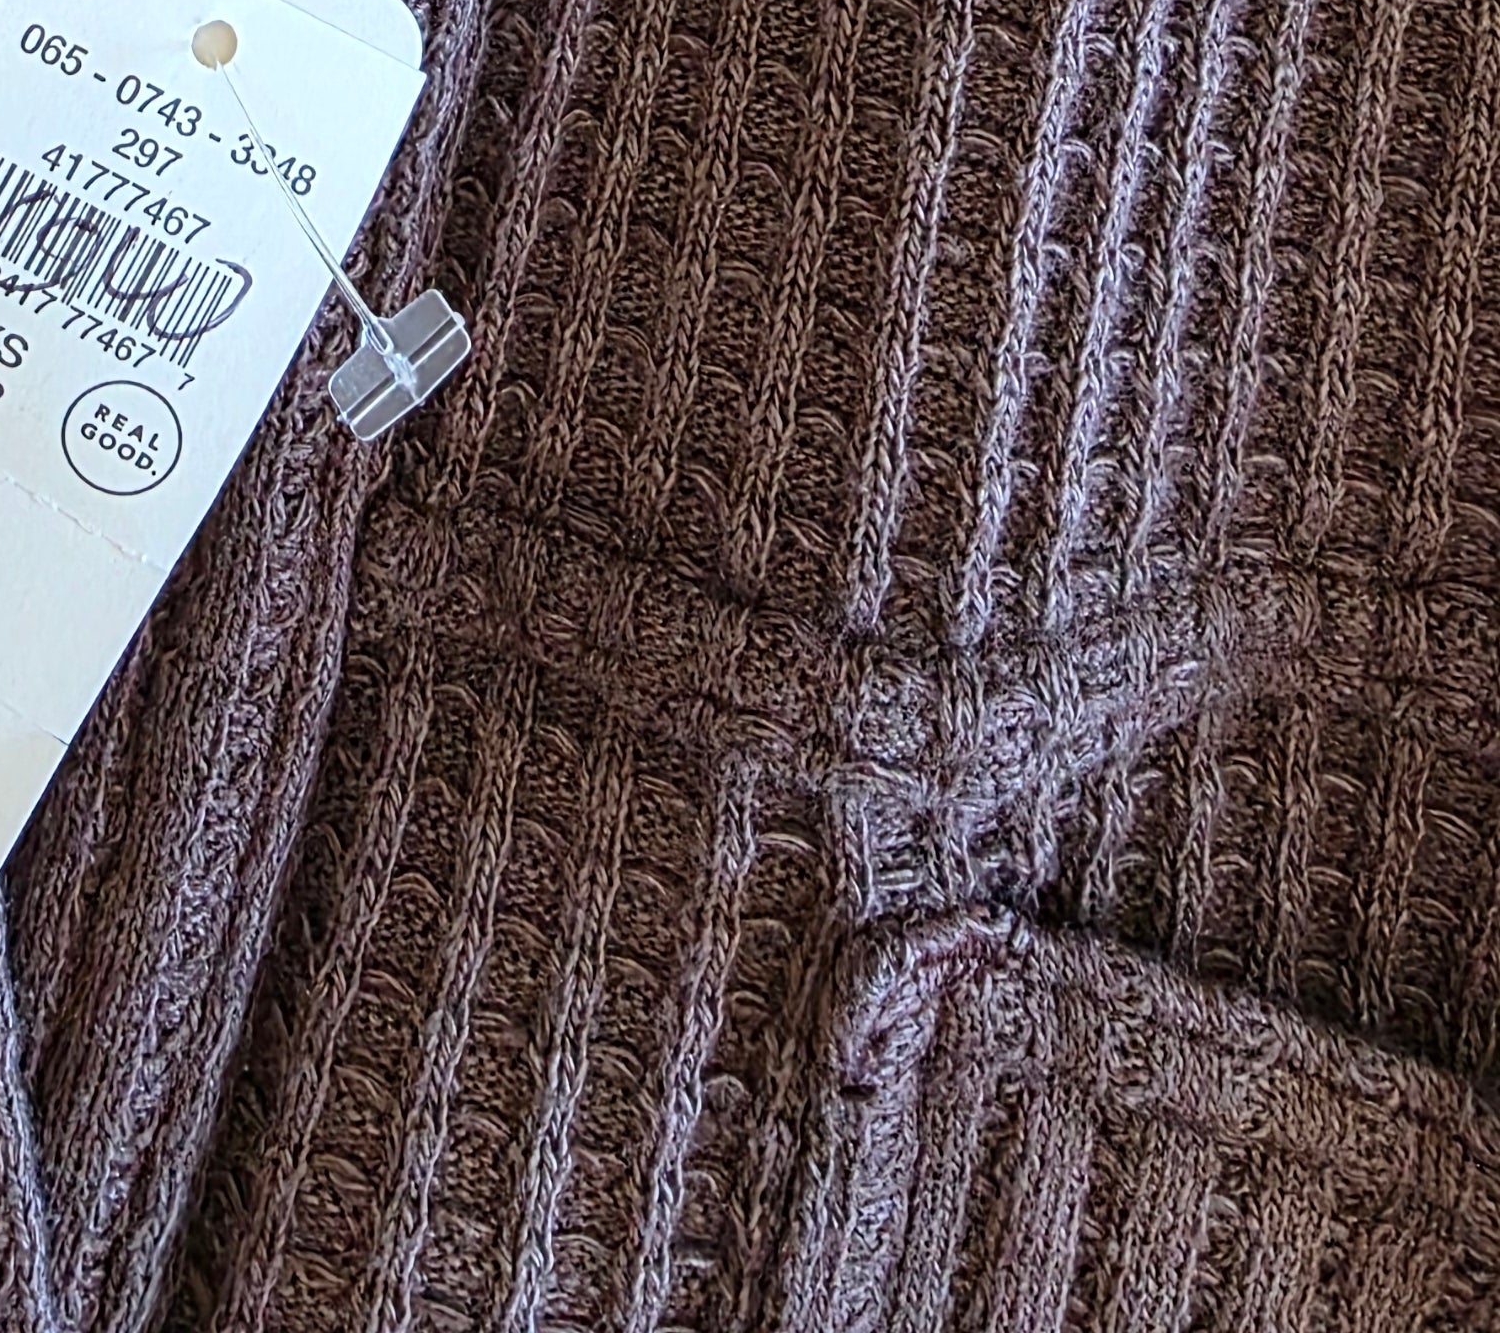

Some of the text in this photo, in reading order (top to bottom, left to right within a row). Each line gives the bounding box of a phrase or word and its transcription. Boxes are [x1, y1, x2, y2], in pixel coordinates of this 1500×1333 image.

[19, 23, 88, 76] 065
[115, 74, 202, 138] 0743
[41, 143, 212, 245] 41777467
[111, 127, 184, 178] 297
[62, 305, 157, 369] 77467
[177, 372, 196, 391] 7
[94, 403, 159, 452] REAL
